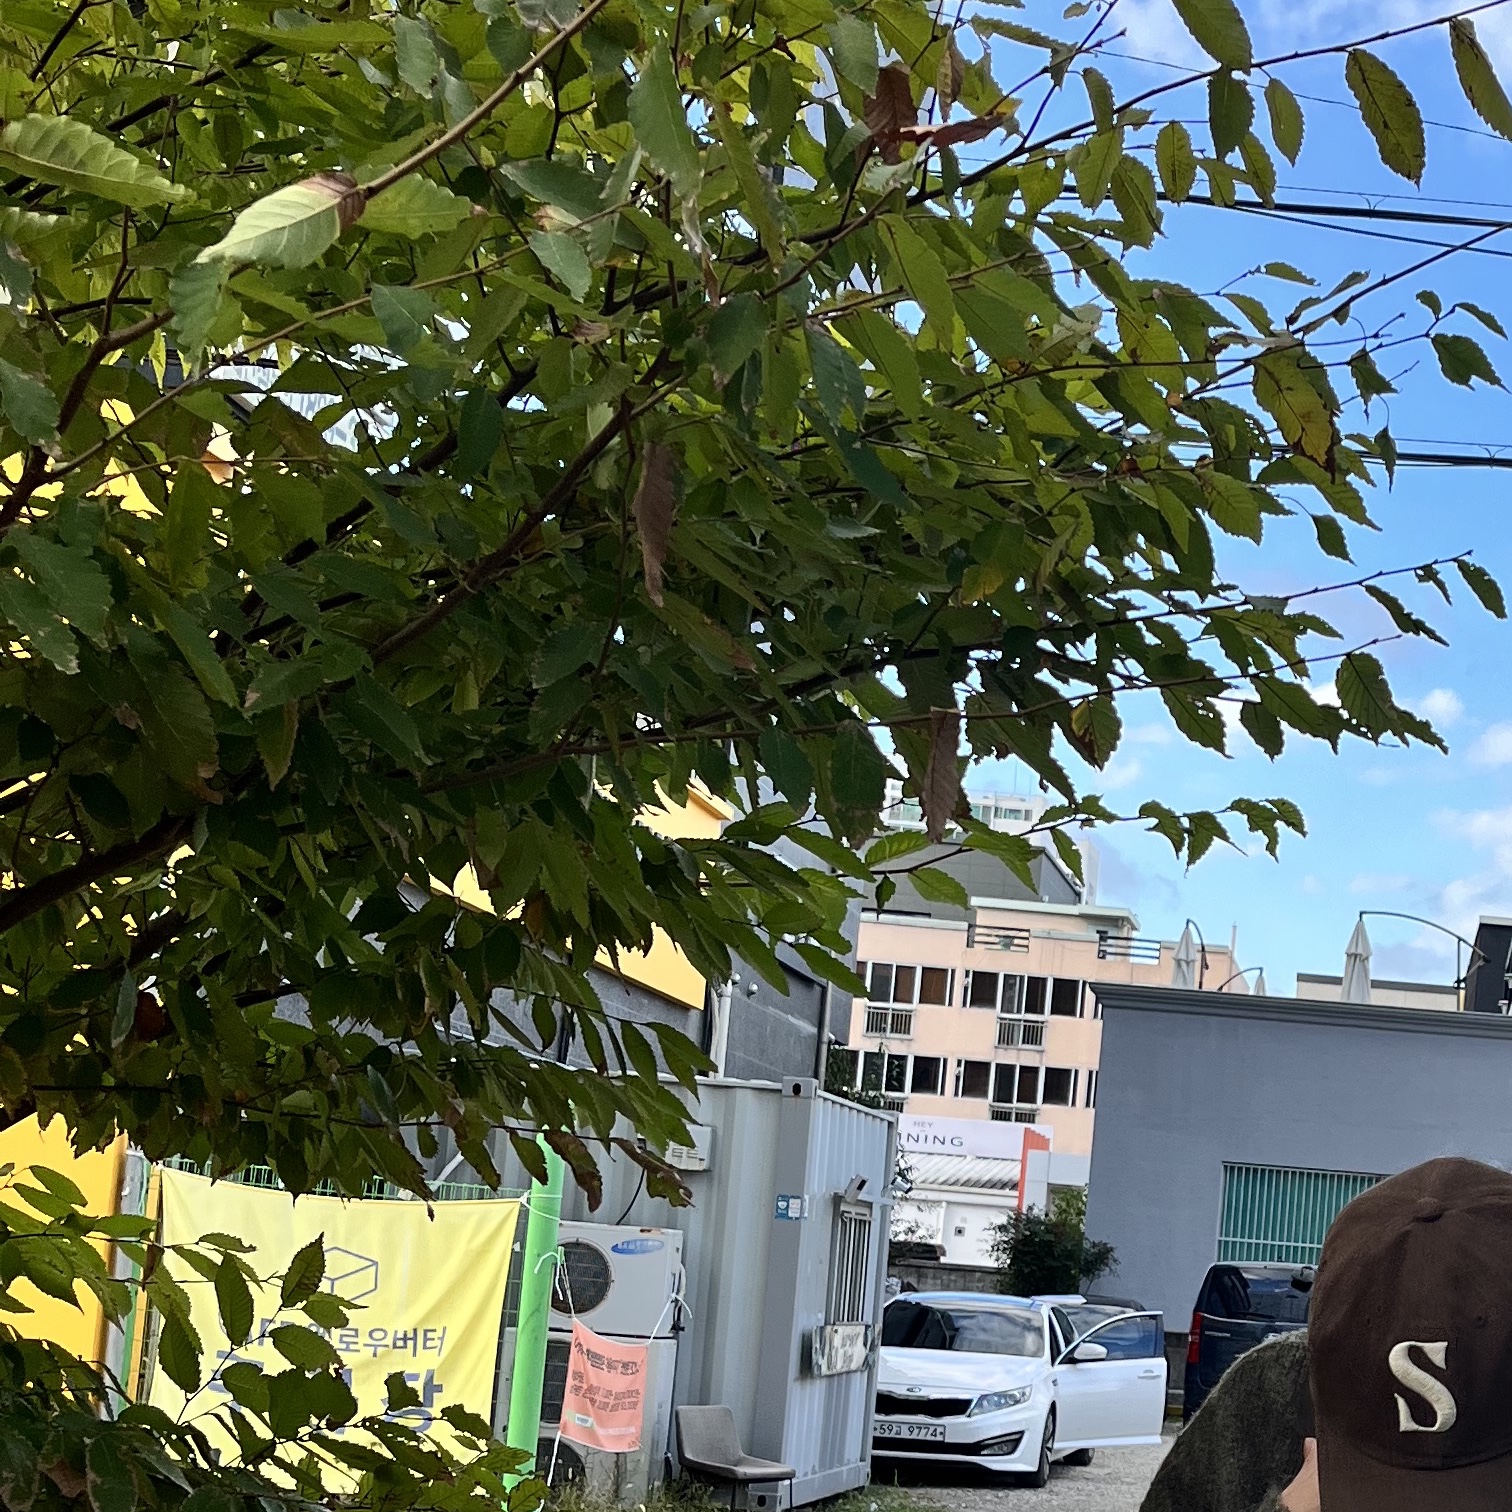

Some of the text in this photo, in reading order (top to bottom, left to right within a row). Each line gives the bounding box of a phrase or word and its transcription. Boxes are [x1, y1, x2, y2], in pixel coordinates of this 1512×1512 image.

[913, 1120, 934, 1129] HEY
[1388, 1341, 1457, 1433] S
[907, 1426, 938, 1438] 9774
